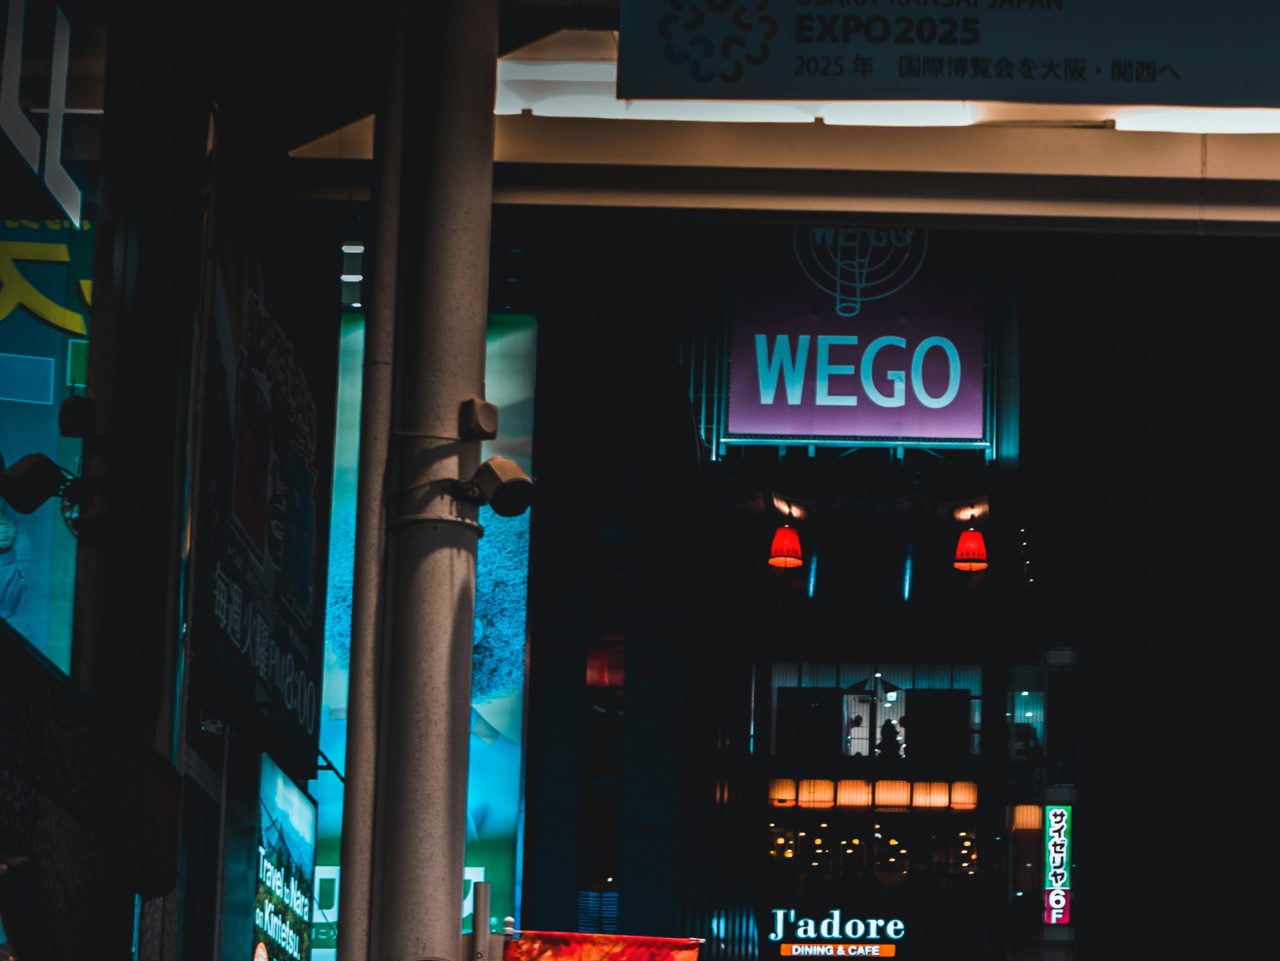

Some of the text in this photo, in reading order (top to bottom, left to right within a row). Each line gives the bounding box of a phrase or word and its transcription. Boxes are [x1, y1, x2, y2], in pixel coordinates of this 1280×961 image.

[793, 55, 844, 76] 2025
[850, 55, 874, 78] 年
[755, 334, 961, 408] WEGO
[1049, 808, 1067, 885] サイゼリヤ
[258, 844, 285, 894] Travel
[290, 882, 311, 918] Nara
[768, 908, 906, 942] J'adore
[1049, 889, 1067, 924] 6F
[264, 909, 301, 961] Kintetsu.
[791, 945, 881, 957] DINING & CAFE
